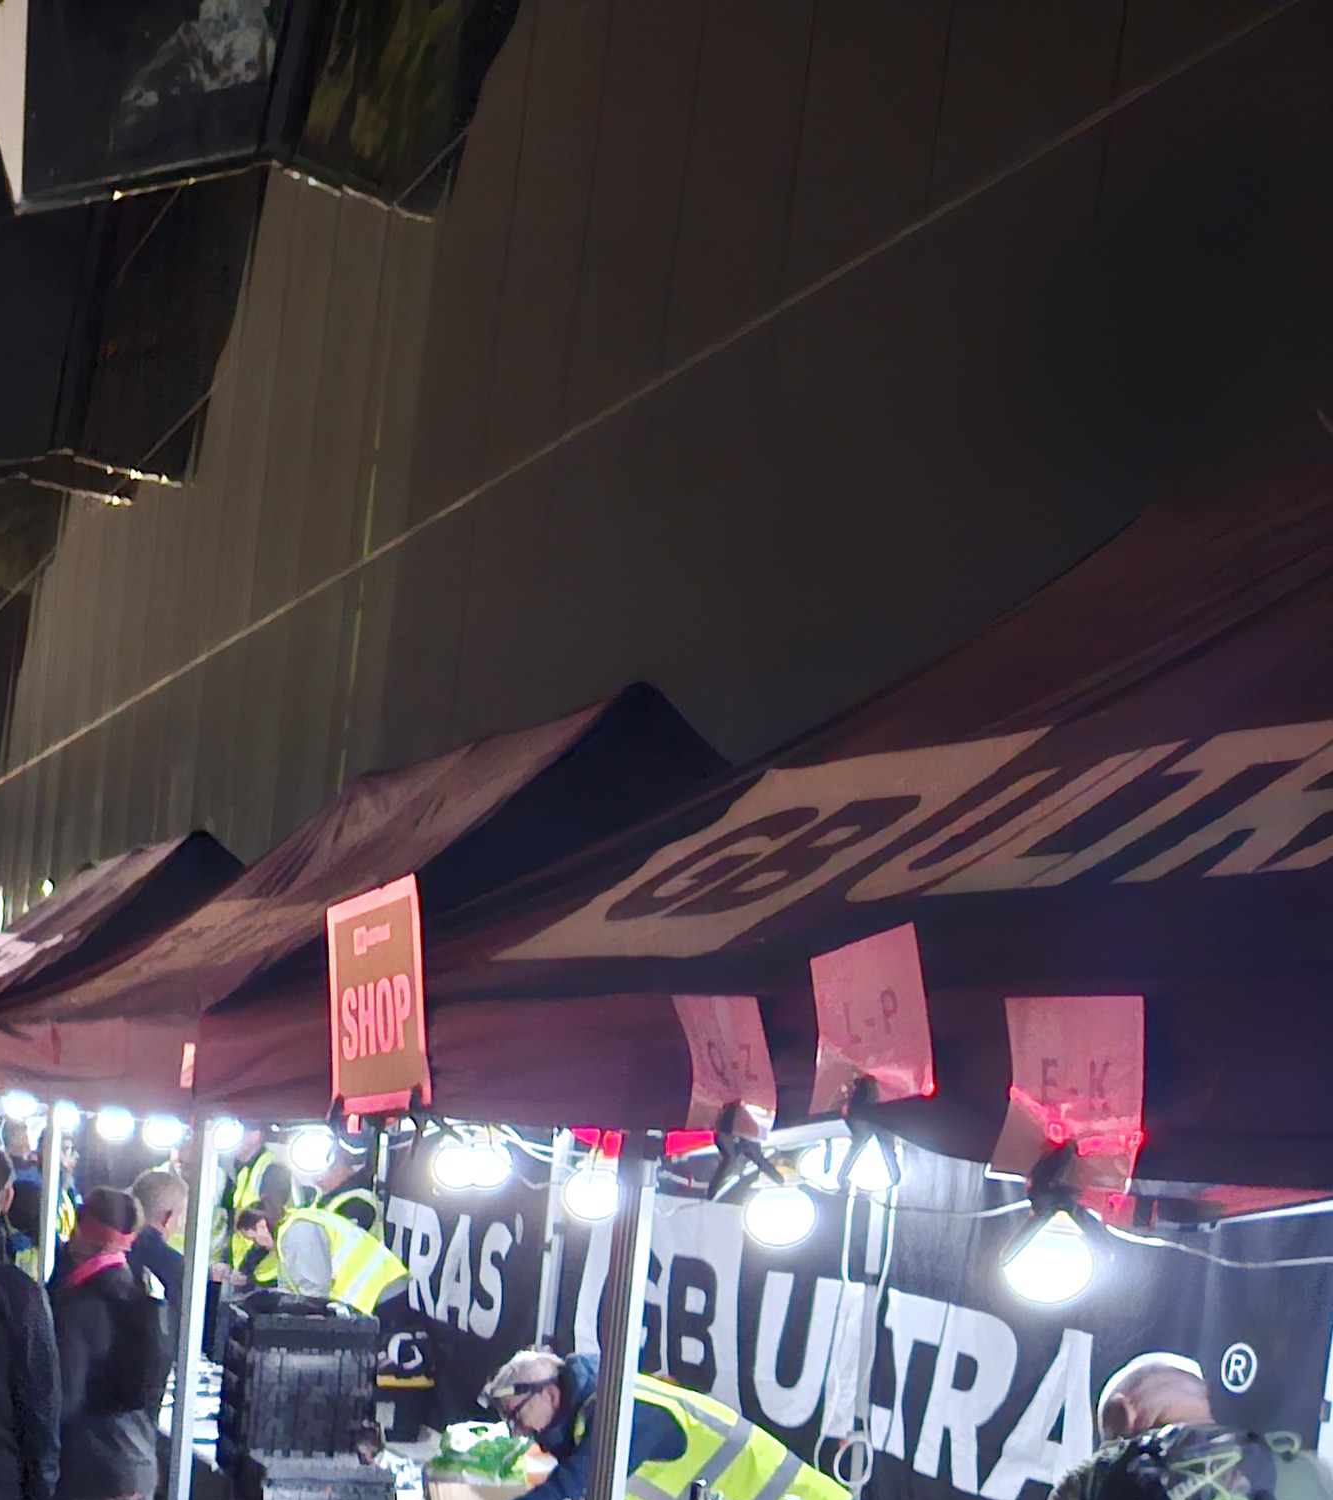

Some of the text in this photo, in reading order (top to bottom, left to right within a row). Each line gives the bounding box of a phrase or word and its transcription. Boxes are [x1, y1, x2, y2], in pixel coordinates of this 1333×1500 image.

[846, 721, 1333, 902] ULTR
[341, 973, 412, 1061] SHOP
[385, 1195, 514, 1340] TRAS
